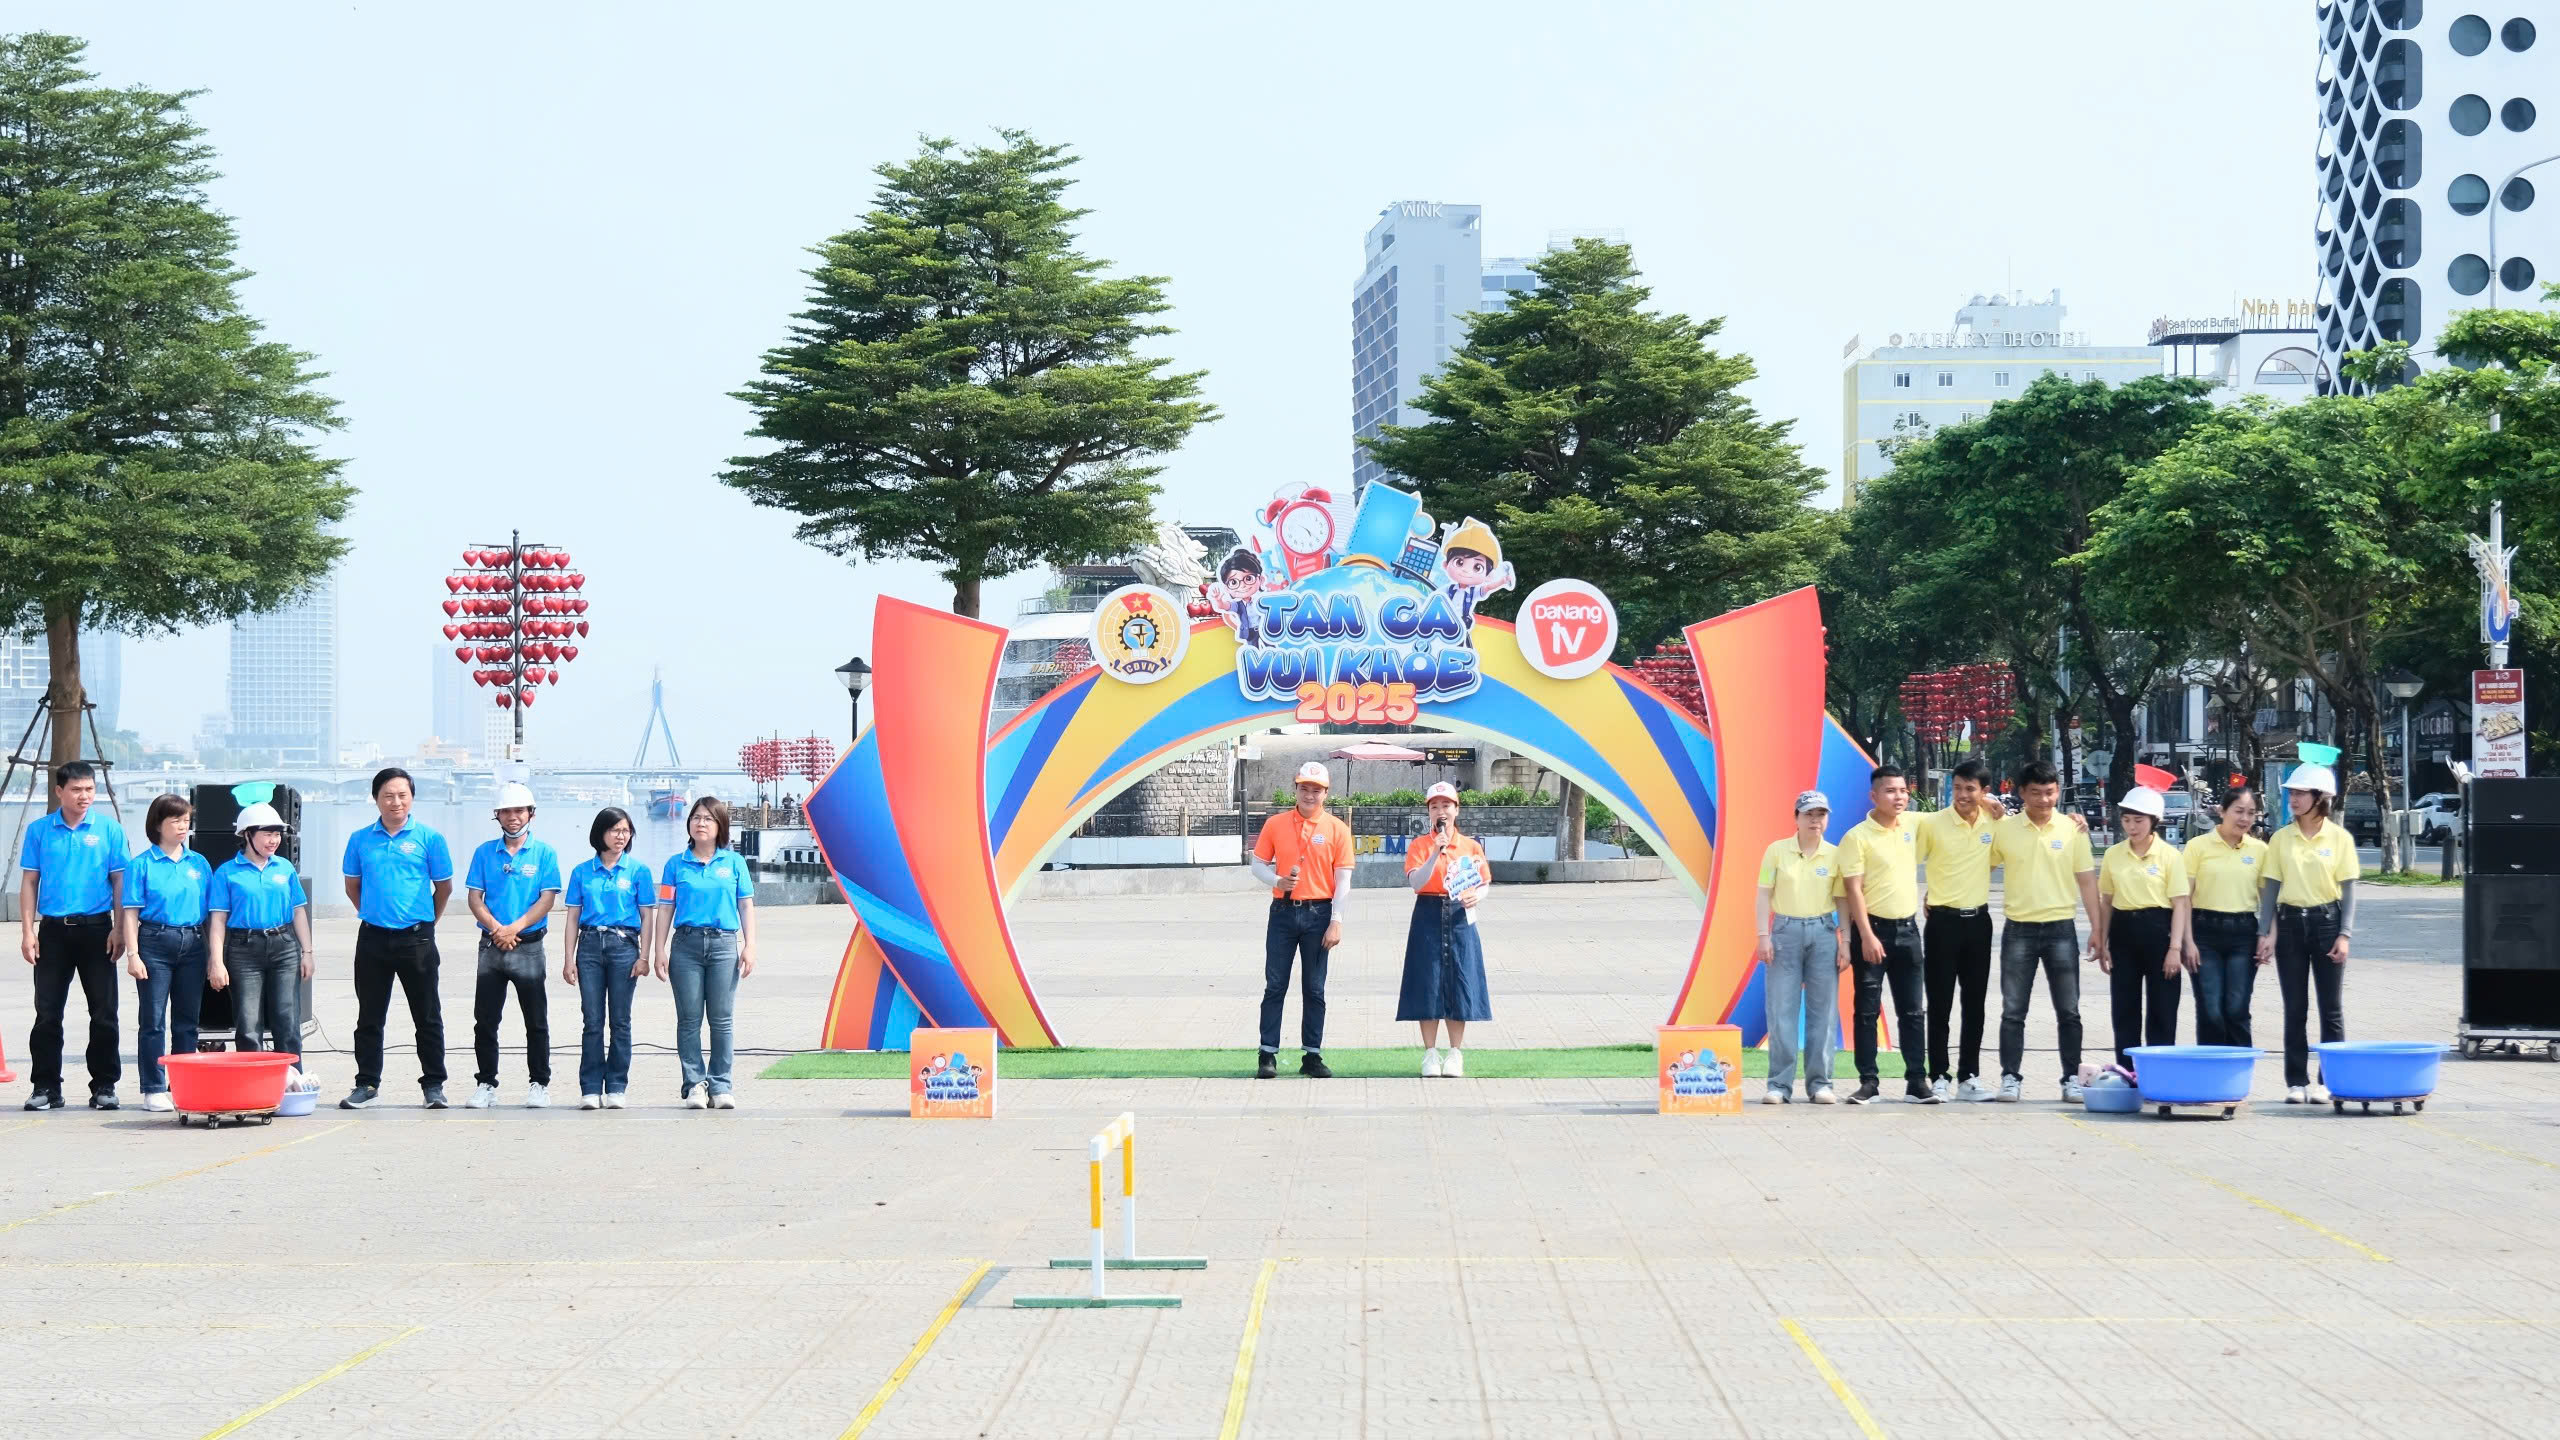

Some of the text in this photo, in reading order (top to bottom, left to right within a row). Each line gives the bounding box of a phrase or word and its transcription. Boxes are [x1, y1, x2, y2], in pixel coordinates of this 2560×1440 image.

[1401, 204, 1442, 217] WINK
[2242, 298, 2279, 315] Nhà
[2168, 316, 2239, 329] Seafood Buffet
[1908, 332, 2090, 348] MERRY HOTEL
[1258, 593, 1463, 640] TAN CA
[1535, 604, 1602, 624] DaNang
[1242, 640, 1479, 693] VUI KHỎE
[1296, 682, 1418, 724] 2025
